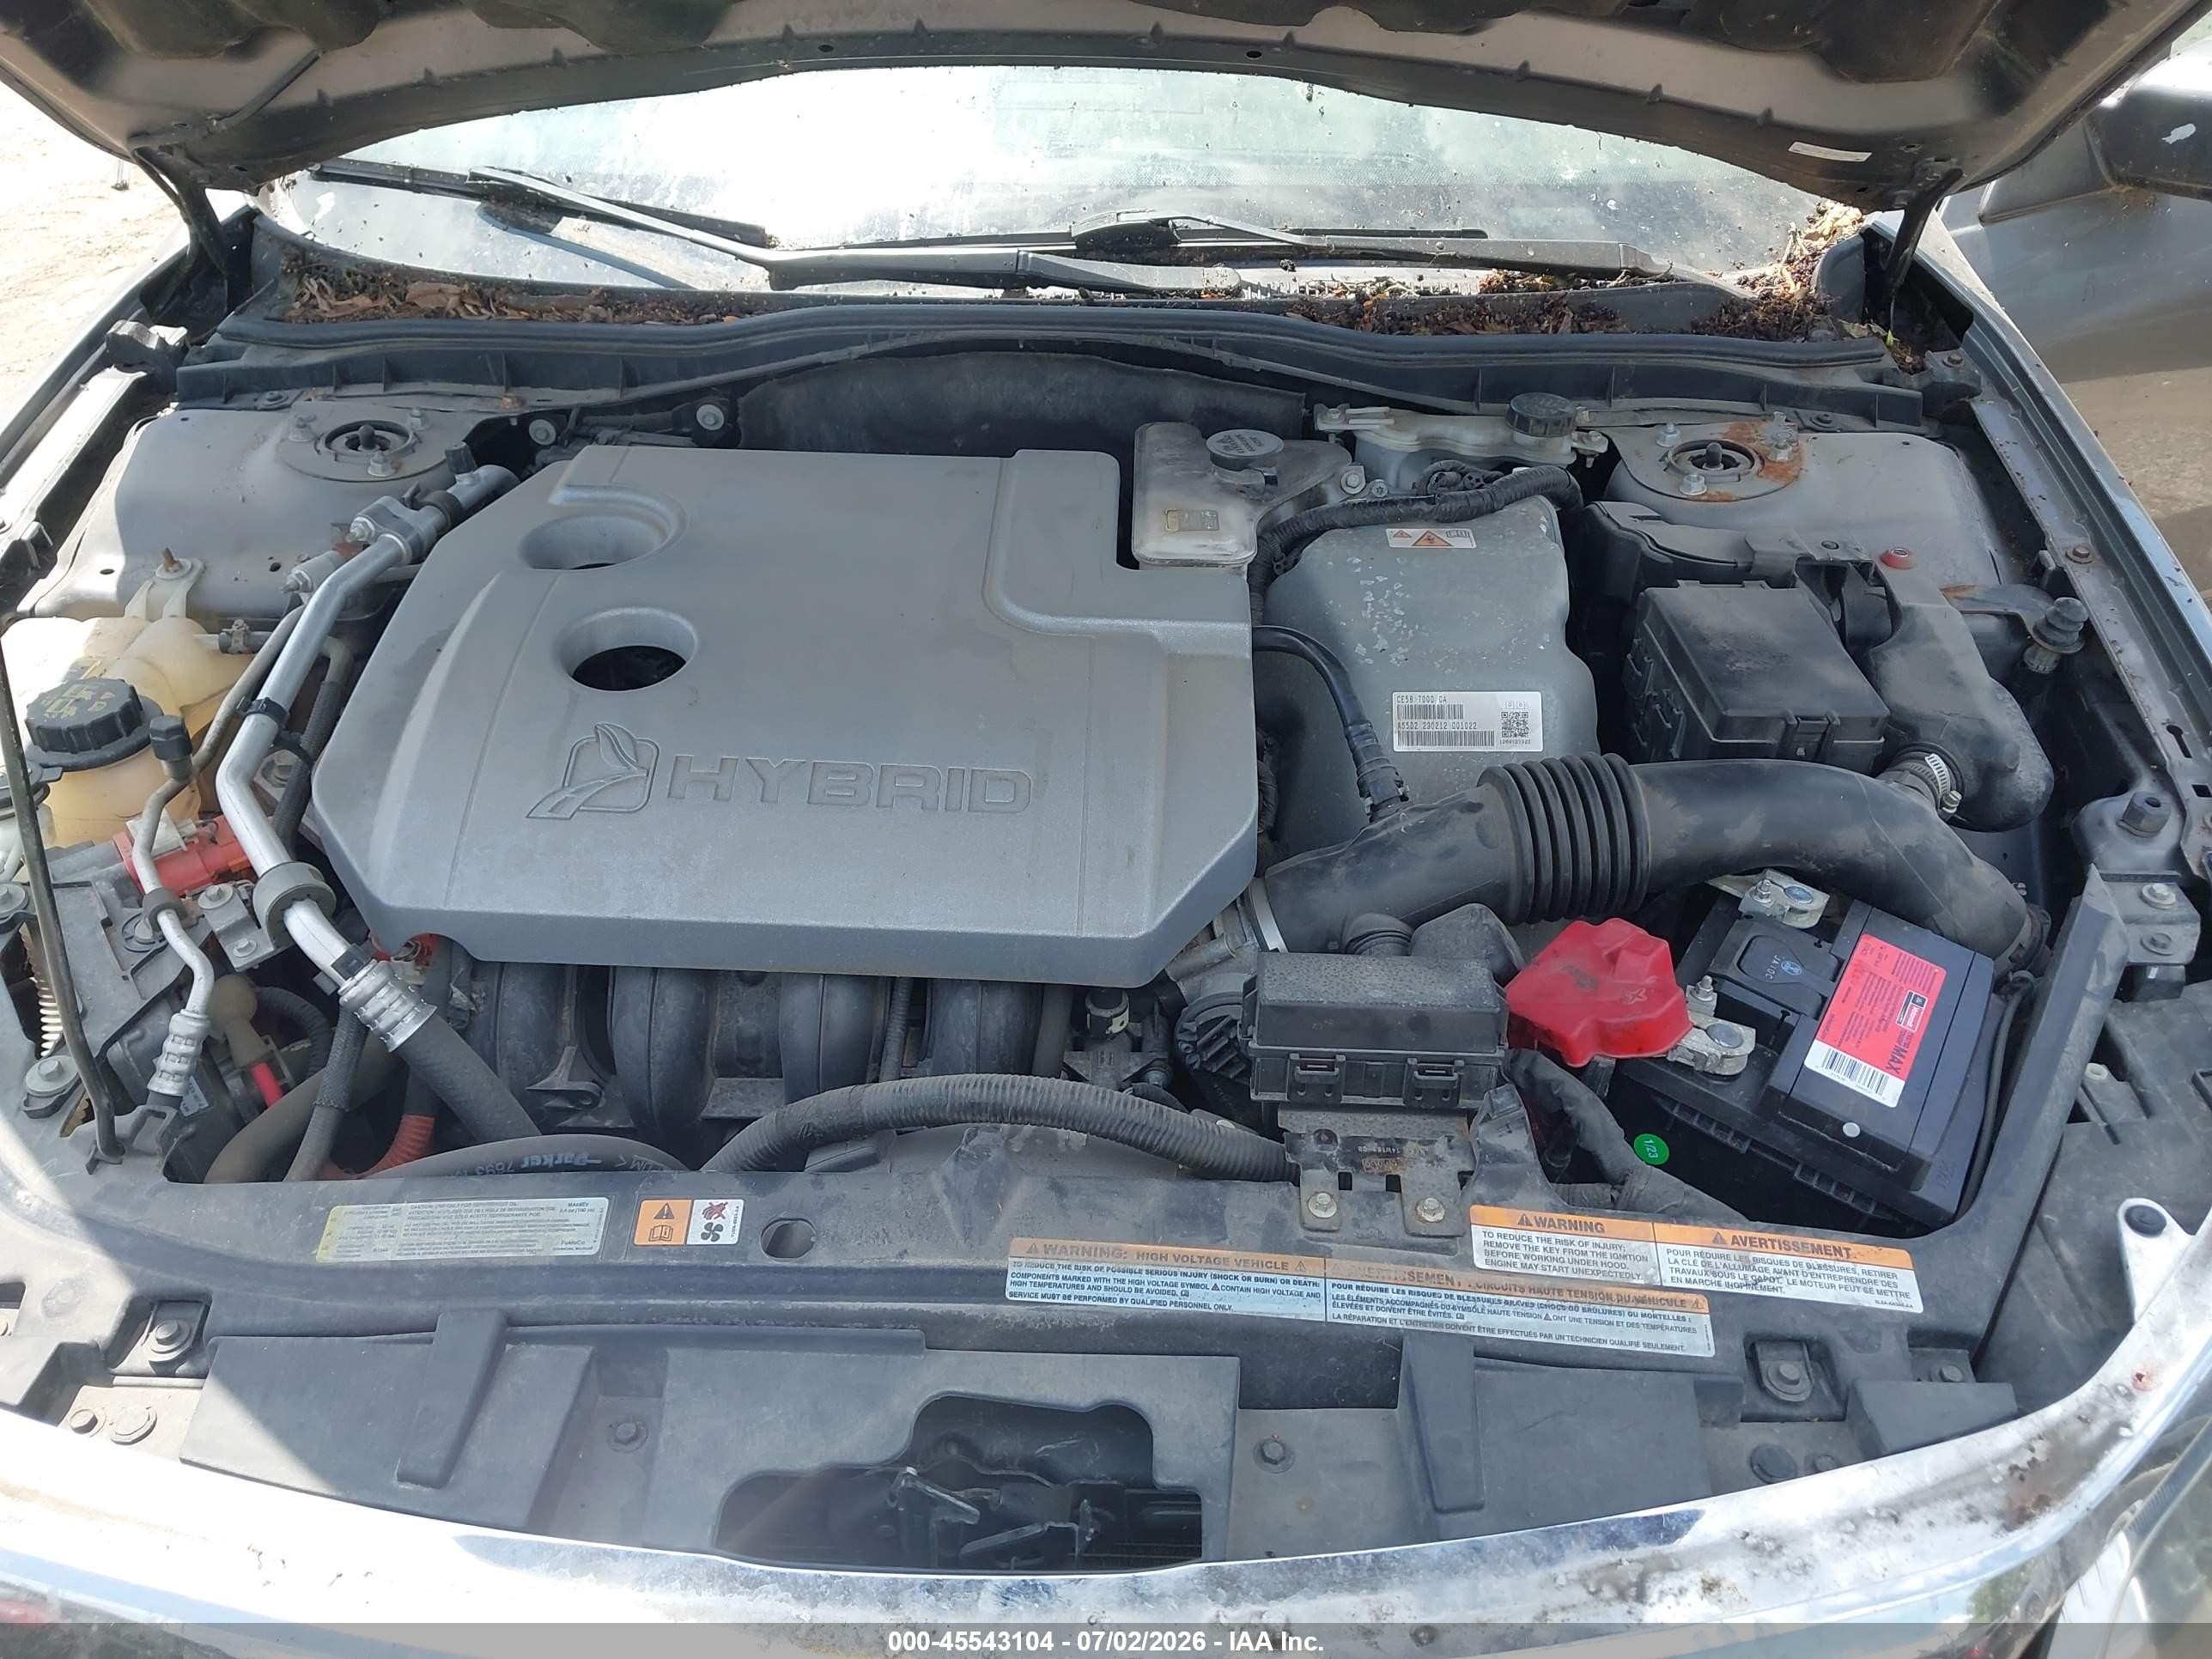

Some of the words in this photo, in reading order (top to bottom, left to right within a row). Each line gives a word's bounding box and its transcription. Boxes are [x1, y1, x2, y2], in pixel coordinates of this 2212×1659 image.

[667, 754, 1031, 813] HYBRID
[1886, 1044, 1908, 1074] MAX
[520, 1152, 591, 1167] Parker
[1644, 1139, 1660, 1158] 1/23
[1534, 1216, 1605, 1233] WARNING
[1482, 1231, 1494, 1239] TO
[1497, 1231, 1533, 1243] REDUCE
[1535, 1234, 1553, 1244] THE
[1555, 1237, 1576, 1247] RISK
[1578, 1239, 1589, 1248] OF
[1731, 1235, 1850, 1258] AVERTISSEMENT
[1043, 1244, 1127, 1259] WARNING:
[1137, 1252, 1169, 1261] HIGH
[1173, 1255, 1230, 1266] VOLTAGE
[1234, 1259, 1289, 1270] VEHICLE
[1483, 1240, 1520, 1250] REMOVE
[1522, 1243, 1540, 1252] THE
[1543, 1245, 1559, 1254] KEY
[1563, 1247, 1588, 1257] FROM
[1590, 1249, 1607, 1259] THE
[1610, 1251, 1648, 1262] IGNITION
[1484, 1249, 1521, 1260] BEFORE
[1522, 1252, 1565, 1264] WORKING
[1568, 1256, 1598, 1267] UNDER
[1601, 1260, 1629, 1270] HOOD.
[1485, 1259, 1518, 1269] ENGINE
[1521, 1261, 1539, 1271] MAY
[1541, 1263, 1570, 1273] START
[1572, 1266, 1644, 1279] UNEXPECTEDLY.
[1667, 1249, 1691, 1258] POUR
[1693, 1250, 1731, 1261] RÉDUIRE
[1753, 1257, 1790, 1267] RISQUES
[1792, 1260, 1803, 1268] DE
[1862, 1267, 1898, 1279] RETIRER
[1682, 1258, 1698, 1267] CLÉ
[1701, 1261, 1713, 1269] DE
[1715, 1262, 1770, 1274] L'ALLUMAGE
[1772, 1267, 1799, 1278] AVANT
[1802, 1271, 1881, 1286] D'ENTREPRENDRE
[1882, 1279, 1898, 1288] DES
[1011, 1273, 1060, 1281] COMPONENTS
[1147, 1279, 1178, 1288] VOLTAGE
[1181, 1281, 1209, 1291] SYMBOL
[1220, 1285, 1251, 1293] CONTAIN
[1273, 1289, 1304, 1297] VOLTAGE
[1029, 1282, 1085, 1291] TEMPERATURES
[1106, 1266, 1143, 1274] POSSIBLE
[1146, 1267, 1177, 1276] SERIOUS
[1180, 1269, 1207, 1279] INJURY
[1210, 1273, 1239, 1281] (SHOCK
[1254, 1276, 1278, 1285] BURN)
[1293, 1279, 1320, 1288] DEATH:
[1668, 1267, 1710, 1278] TRAVAUX
[1712, 1271, 1735, 1279] SOUS
[1800, 1279, 1836, 1290] MOTEUR
[1838, 1283, 1860, 1293] PEUT
[1863, 1285, 1875, 1294] SE
[1877, 1287, 1911, 1298] METTRE
[1671, 1276, 1682, 1285] EN
[1685, 1278, 1723, 1288] MARCHE
[1528, 1285, 1564, 1297] HAUTE
[1073, 1295, 1117, 1304] PERFORMED
[1131, 1298, 1167, 1307] QUALIFIED
[1169, 1301, 1212, 1310] PERSONNEL
[1376, 1305, 1405, 1314] DOIVENT
[1456, 1294, 1502, 1304] BLESSURES
[1641, 1312, 1686, 1322] MORTELLES
[1487, 1307, 1510, 1316] HAUTE
[1512, 1310, 1542, 1319] TENSION
[1568, 1315, 1583, 1323] UNE
[1584, 1316, 1614, 1326] TENSION
[1626, 1321, 1640, 1329] DES
[1445, 1323, 1475, 1332] DOIVENT
[1540, 1331, 1553, 1340] PAR
[1566, 1334, 1607, 1345] TECHNICIEN
